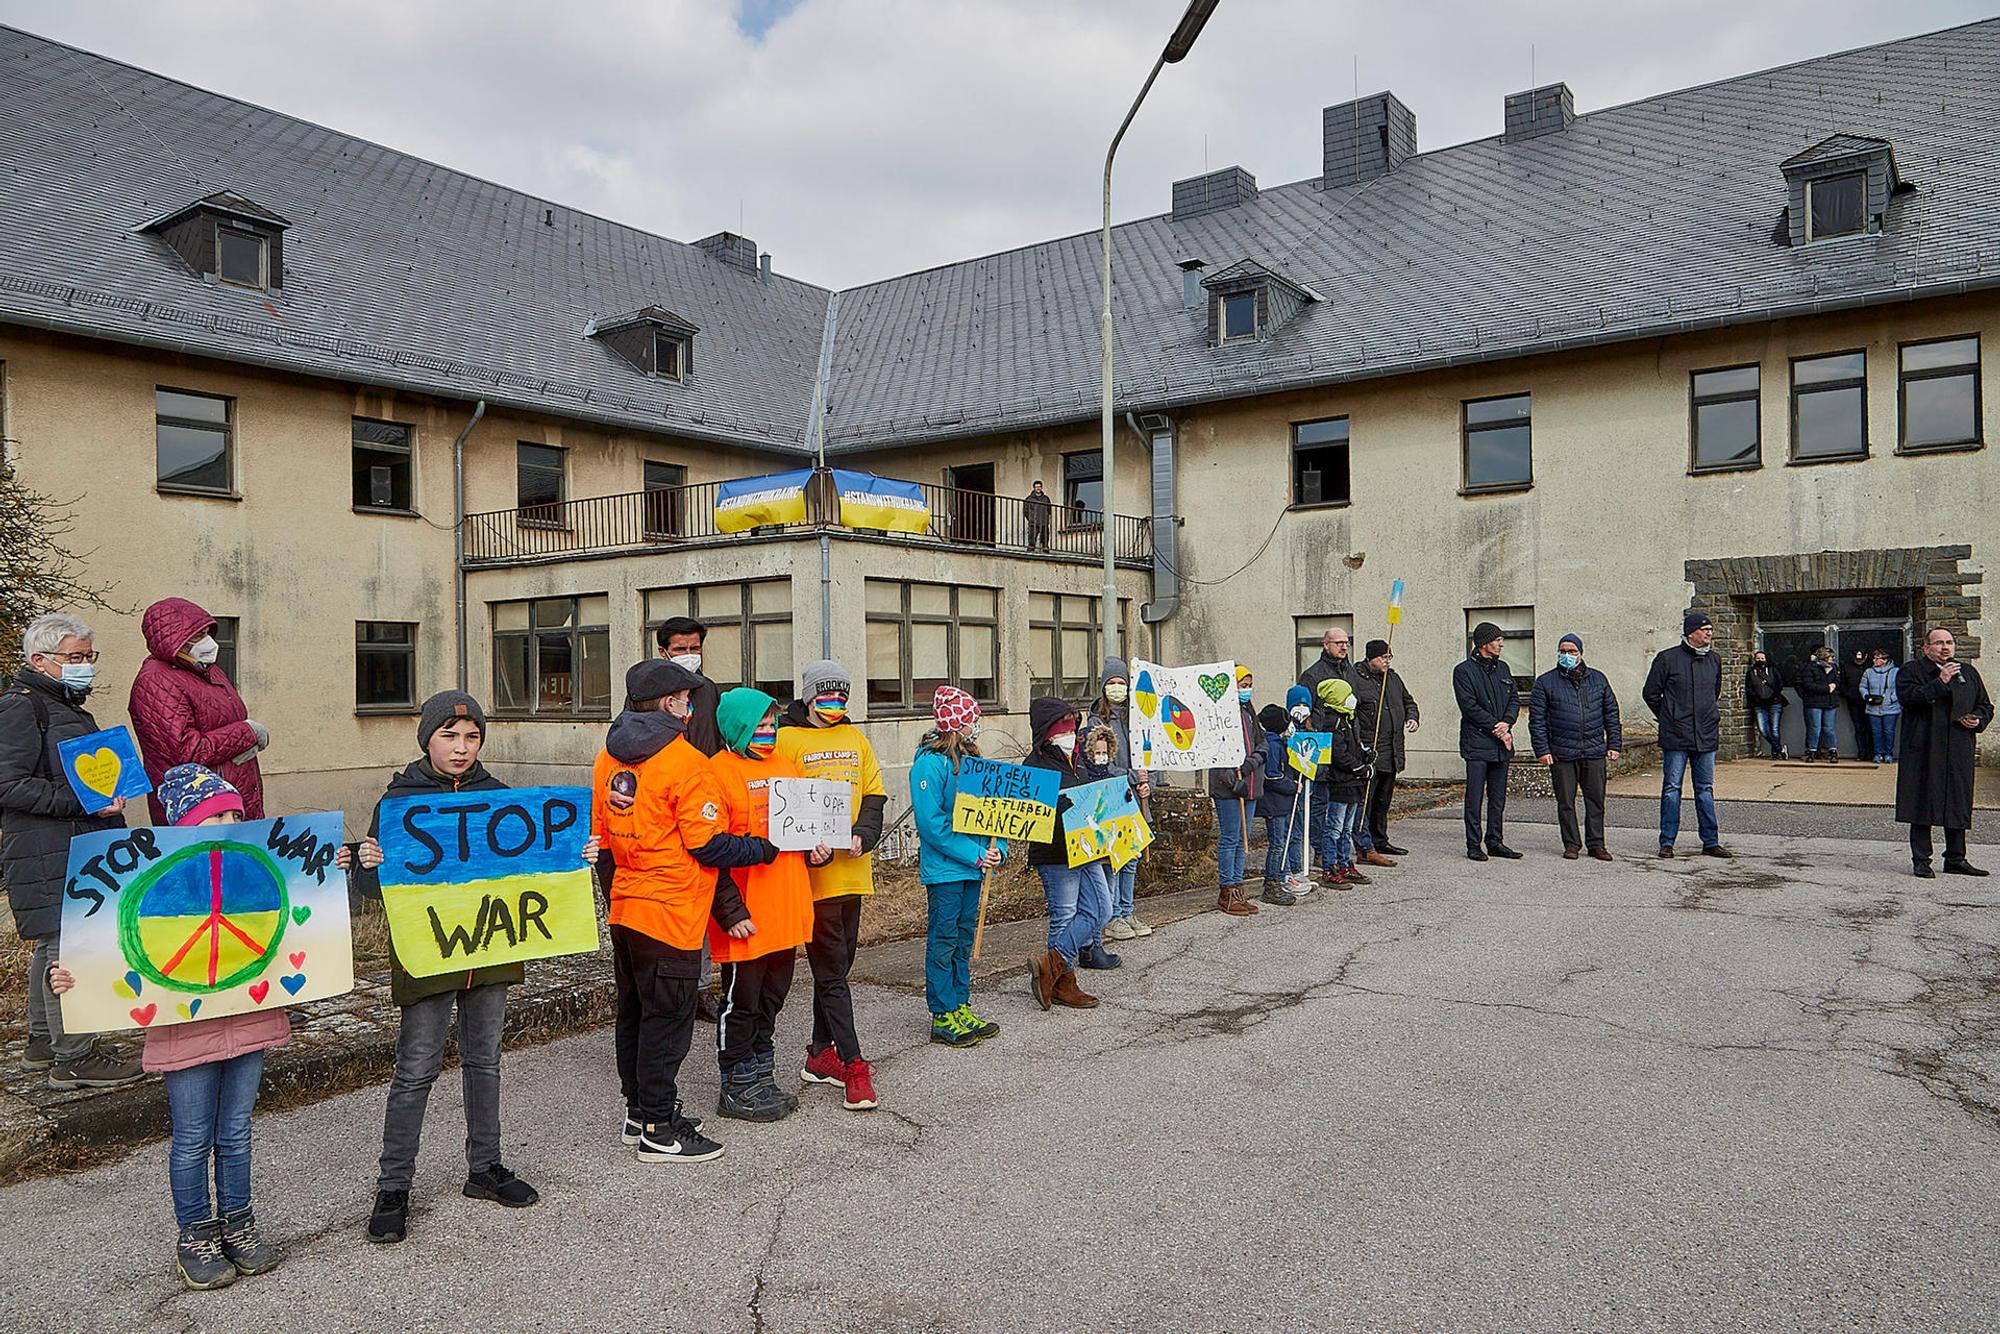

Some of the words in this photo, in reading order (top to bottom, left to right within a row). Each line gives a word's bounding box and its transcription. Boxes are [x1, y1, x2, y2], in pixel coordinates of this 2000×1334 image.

[844, 490, 927, 513] #STANDWITHUKRAINE
[803, 751, 833, 764] FAIRPLAY
[833, 751, 852, 759] CAMP
[981, 774, 1040, 800] KRIEG!
[982, 795, 997, 809] ES
[403, 798, 577, 875] STOP
[962, 807, 1036, 839] TRÄNEN
[66, 828, 162, 918] STOP
[266, 817, 335, 886] WAR
[426, 891, 553, 959] WAR
